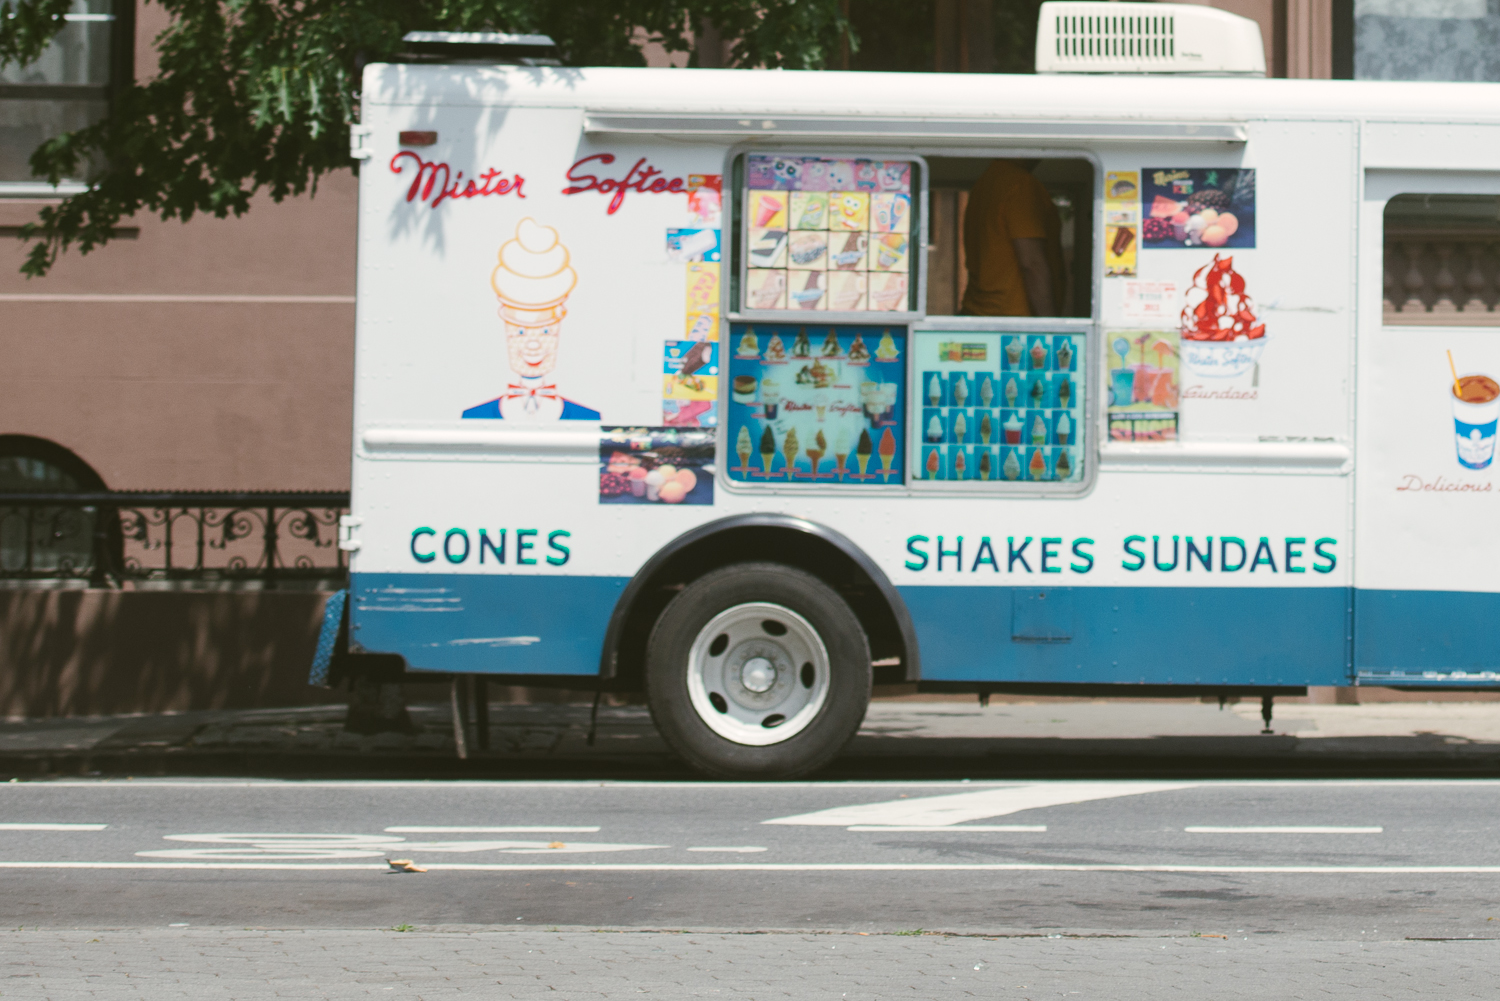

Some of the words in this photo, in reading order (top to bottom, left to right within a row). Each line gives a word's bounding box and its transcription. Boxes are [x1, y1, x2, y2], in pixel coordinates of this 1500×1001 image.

[390, 151, 526, 208] Mister
[562, 154, 688, 215] Softee
[1396, 475, 1492, 493] Delicious
[410, 527, 572, 567] CONES
[904, 534, 1095, 574] SHAKES
[1121, 534, 1338, 574] SUNDAES
